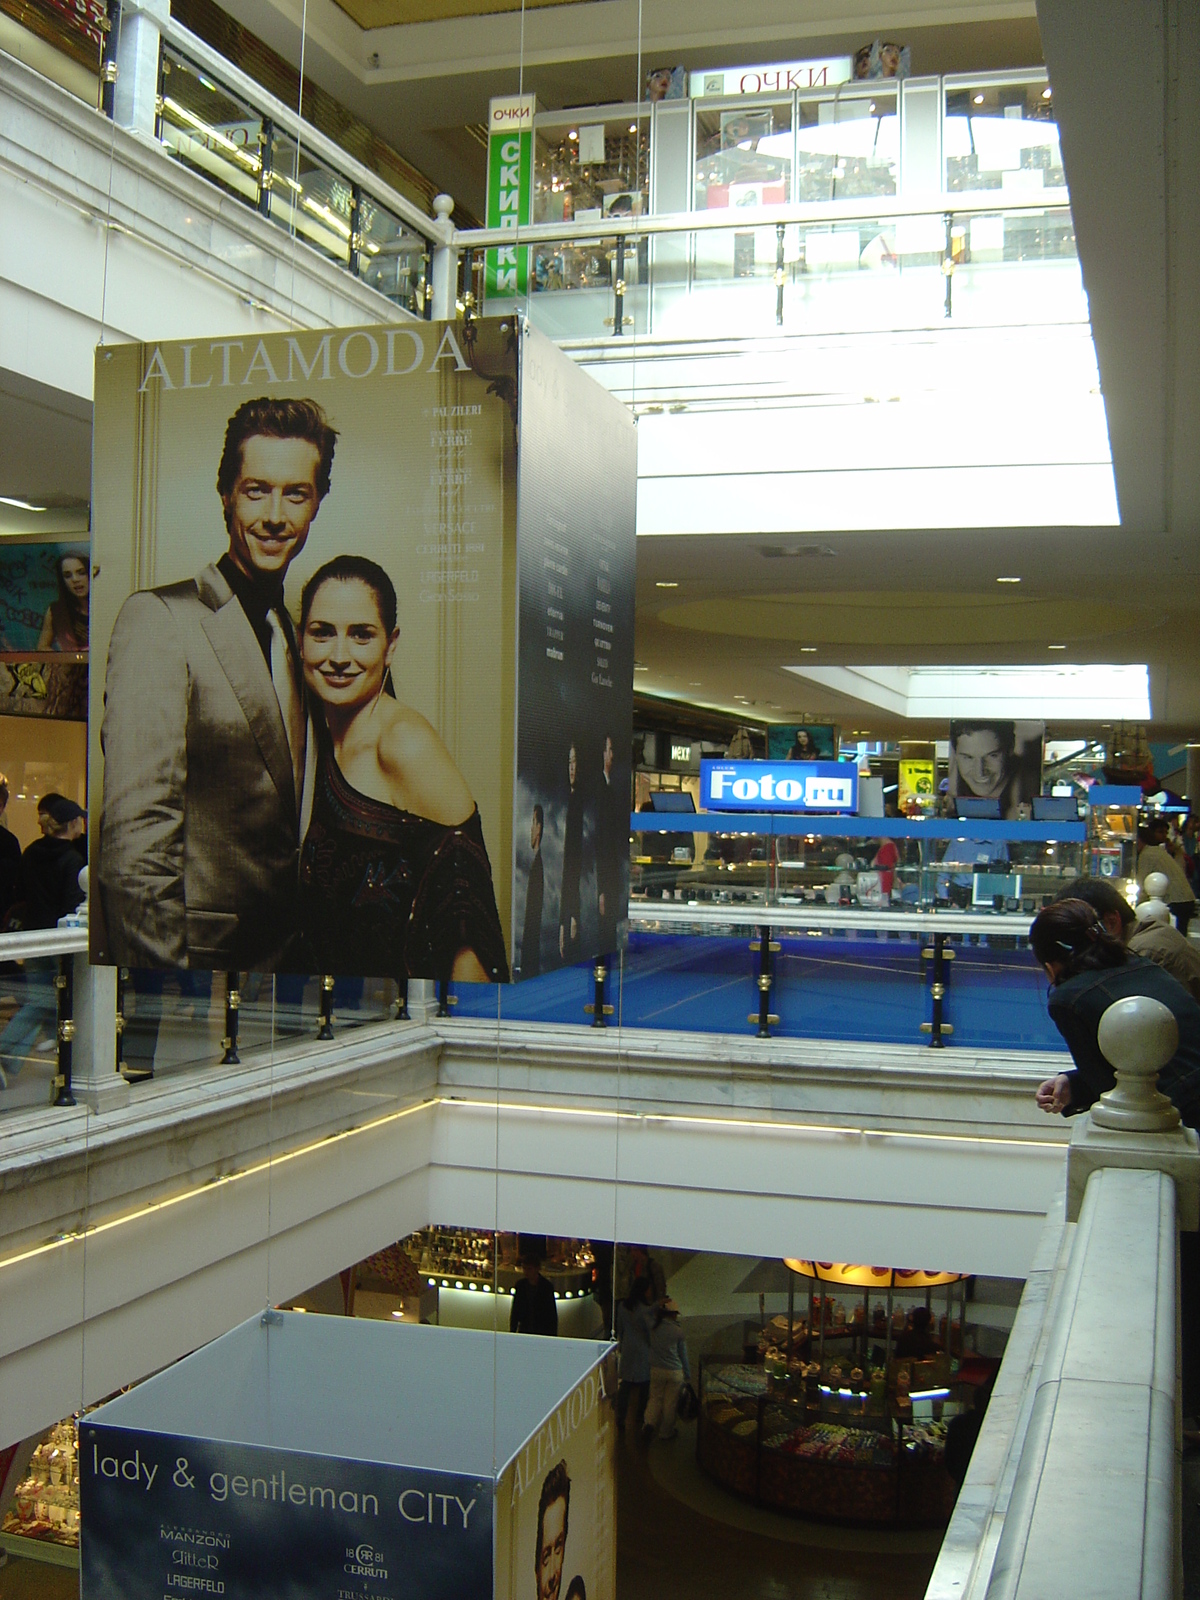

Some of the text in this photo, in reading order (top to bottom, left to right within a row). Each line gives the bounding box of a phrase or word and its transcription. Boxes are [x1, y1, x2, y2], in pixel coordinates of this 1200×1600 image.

[740, 66, 829, 94] ОЧКИ
[493, 107, 530, 121] ОЧКИ
[137, 325, 472, 392] ALTAMODA
[511, 1363, 607, 1506] ALTAMODA
[92, 1444, 478, 1529] lady & gentleman CITY
[160, 1529, 231, 1549] MANZONI
[167, 1573, 226, 1594] LAGERFELD
[343, 1563, 389, 1580] CERRUTI
